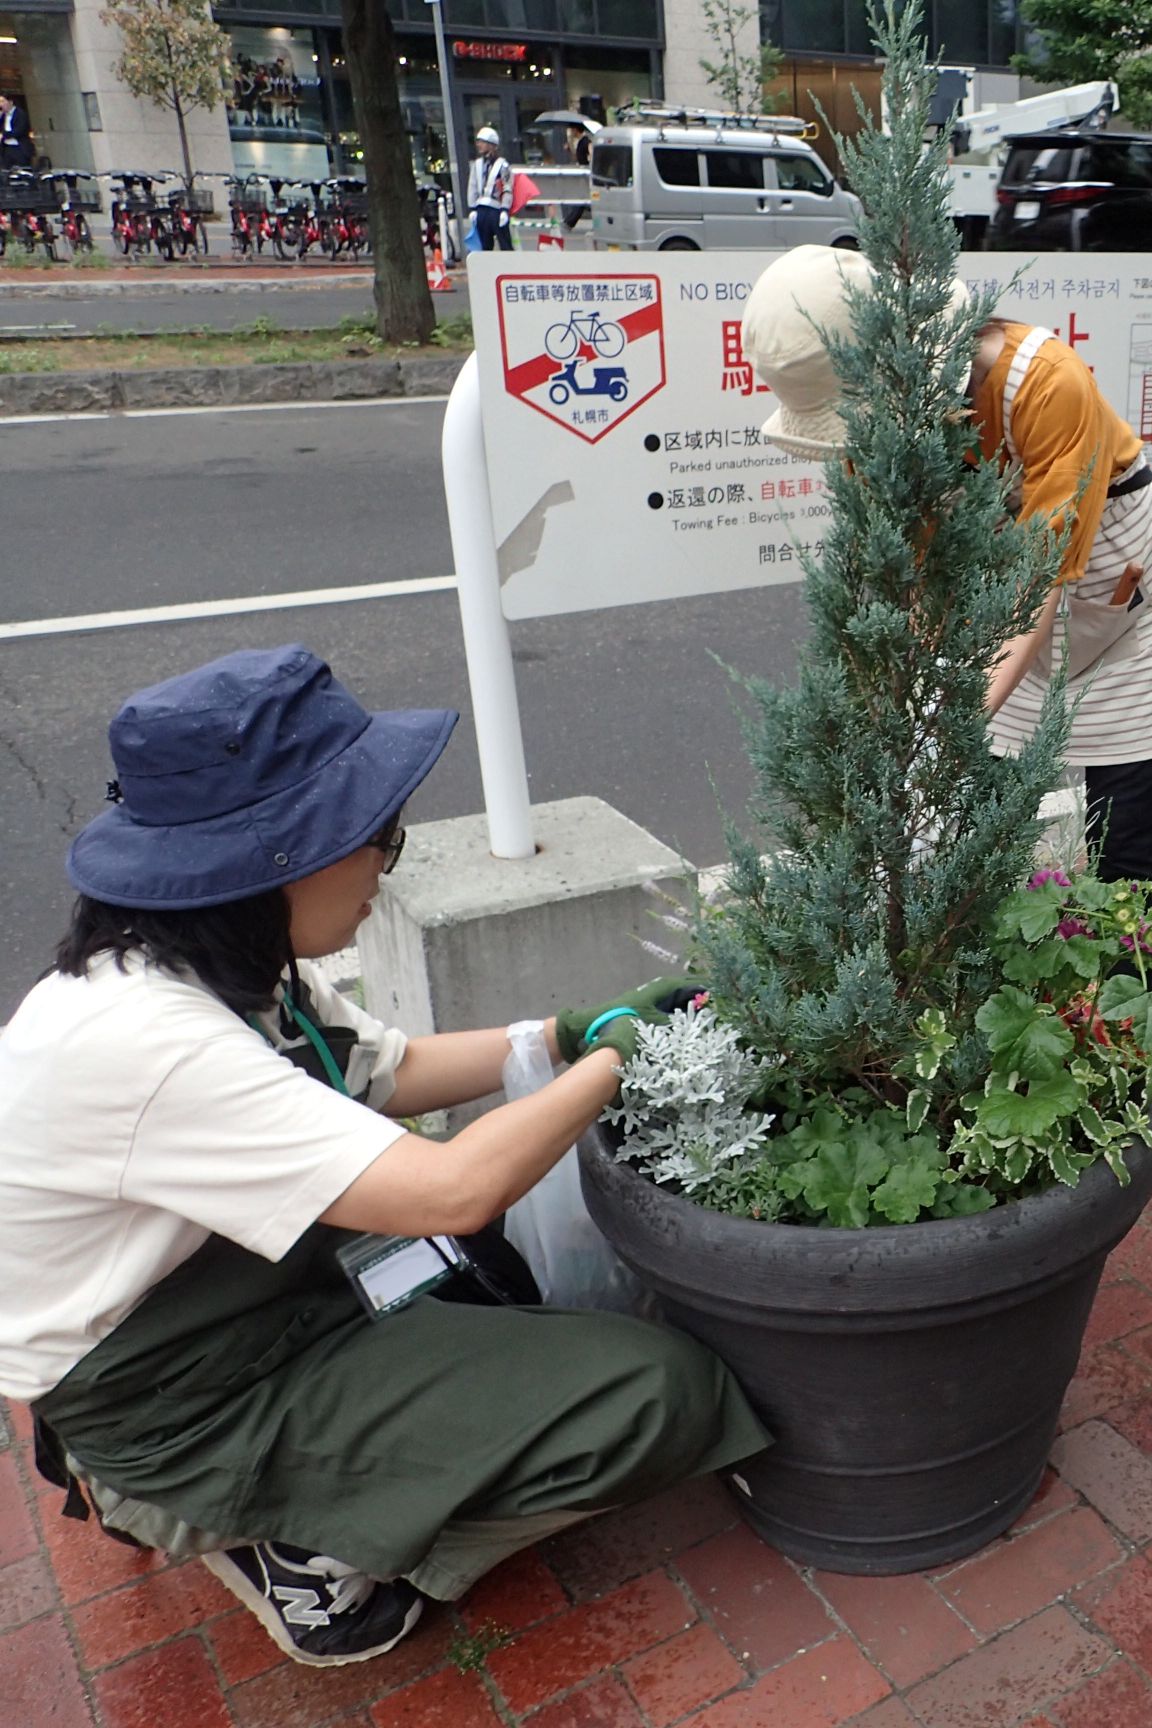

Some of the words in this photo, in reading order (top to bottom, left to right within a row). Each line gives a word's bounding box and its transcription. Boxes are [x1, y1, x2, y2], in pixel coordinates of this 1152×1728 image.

[505, 283, 654, 303] 自転車等放置禁止区域
[680, 282, 709, 301] NO
[715, 282, 753, 301] BIC
[1009, 279, 1055, 299] 자전거
[1061, 279, 1120, 299] 주차금지
[571, 408, 610, 425] 札幌市
[664, 426, 773, 451] 区域内に放
[670, 460, 711, 474] Parked
[715, 455, 788, 471] unauthorized
[672, 519, 713, 531] Towing
[717, 515, 738, 526] Fee
[749, 510, 795, 524] Bicycles
